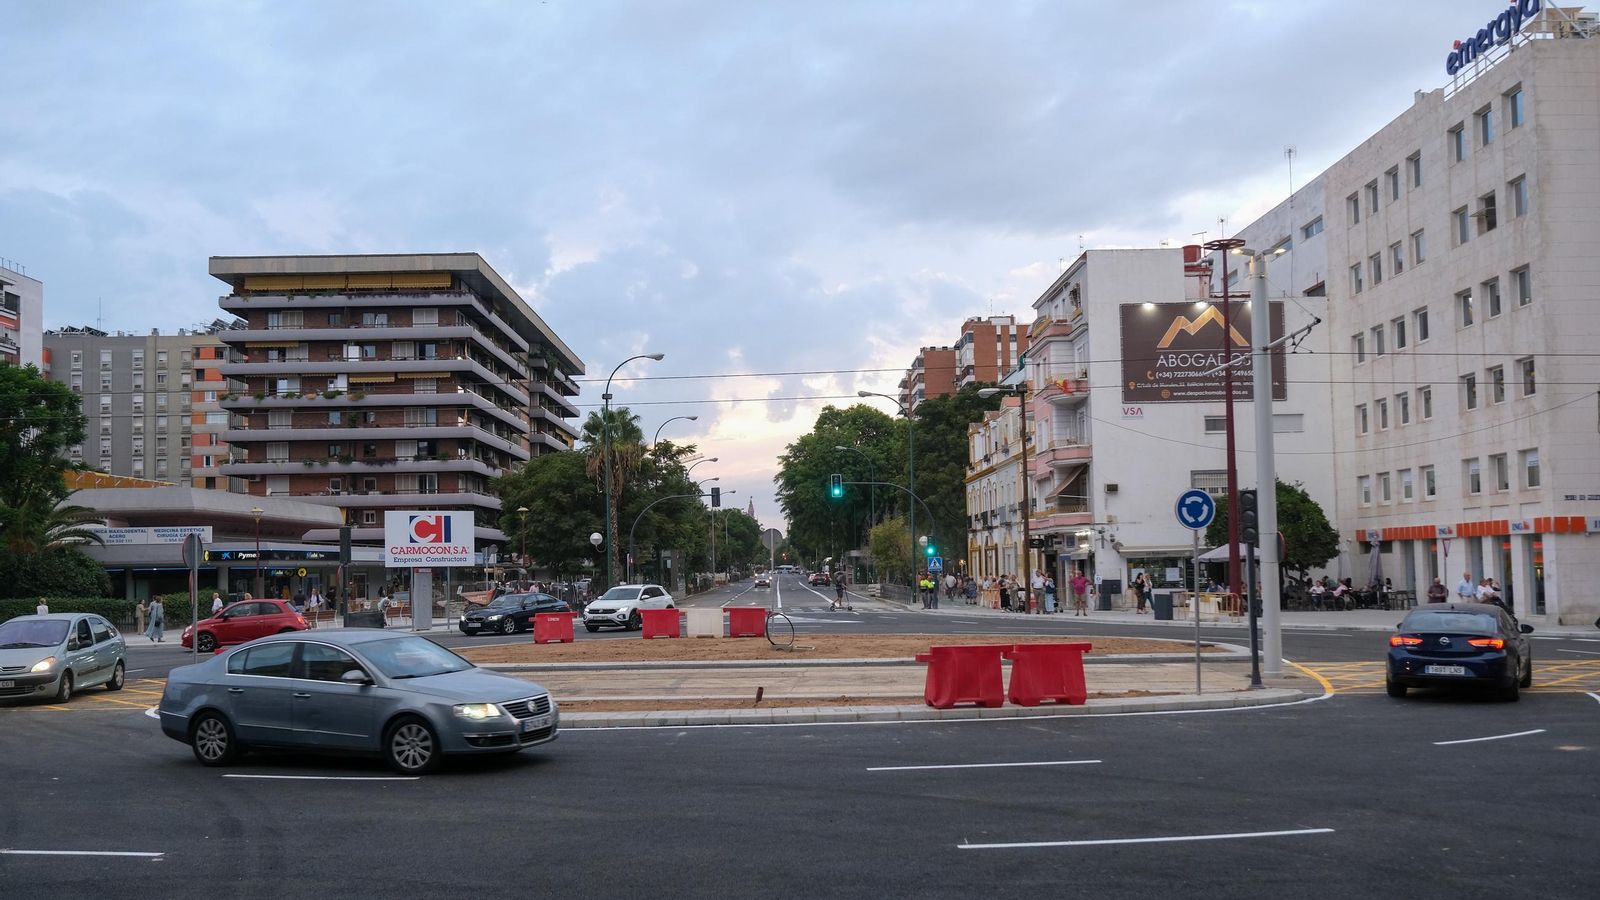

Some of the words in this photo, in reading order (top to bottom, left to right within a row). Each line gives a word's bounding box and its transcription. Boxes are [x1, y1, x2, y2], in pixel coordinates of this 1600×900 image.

[1446, 0, 1540, 76] emergya
[1122, 407, 1143, 416] VSA
[1511, 522, 1523, 531] ING
[393, 556, 422, 564] Empresa
